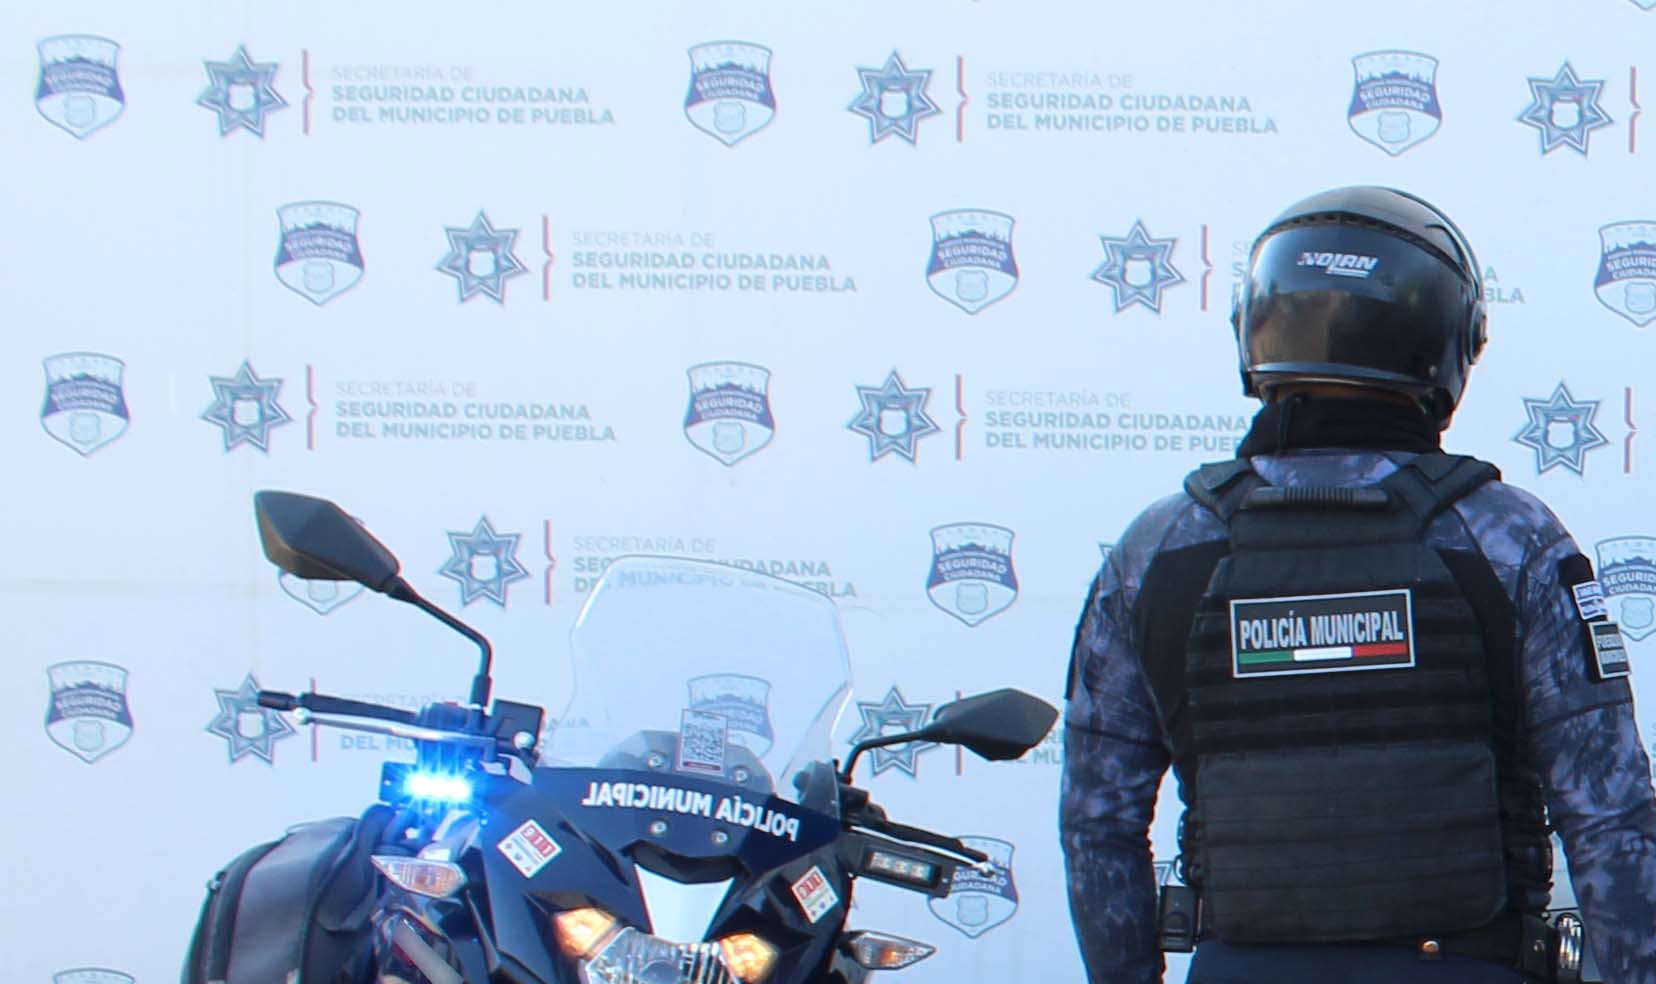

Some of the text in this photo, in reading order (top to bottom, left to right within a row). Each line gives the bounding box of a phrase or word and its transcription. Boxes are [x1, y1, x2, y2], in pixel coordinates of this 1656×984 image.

[333, 84, 588, 105] SEGURIDAD CIUDADANA
[987, 92, 1250, 112] SEGURIDAD CIUDADANA
[333, 106, 614, 124] DEL MUNICIPIO DE PUEBLA
[987, 114, 1277, 133] DEL MUNICIPIO DE PUEBLA
[572, 251, 829, 271] SEGURIDAD CIUDADANA
[1297, 252, 1379, 279] NOLAN
[573, 273, 856, 292] DEL MUNICIPIO DE PUEBLA
[336, 400, 589, 421] SEGURIDAD CIUDADANA
[984, 411, 1246, 432] SEGURIDAD CIUDADANA
[337, 423, 615, 441] DEL MUNICIPIO DE PUEBLA
[985, 432, 1182, 452] DEL MUNICIPIO DE
[1239, 610, 1404, 650] POLICÍA MUNICIPAL
[521, 824, 557, 858] 911
